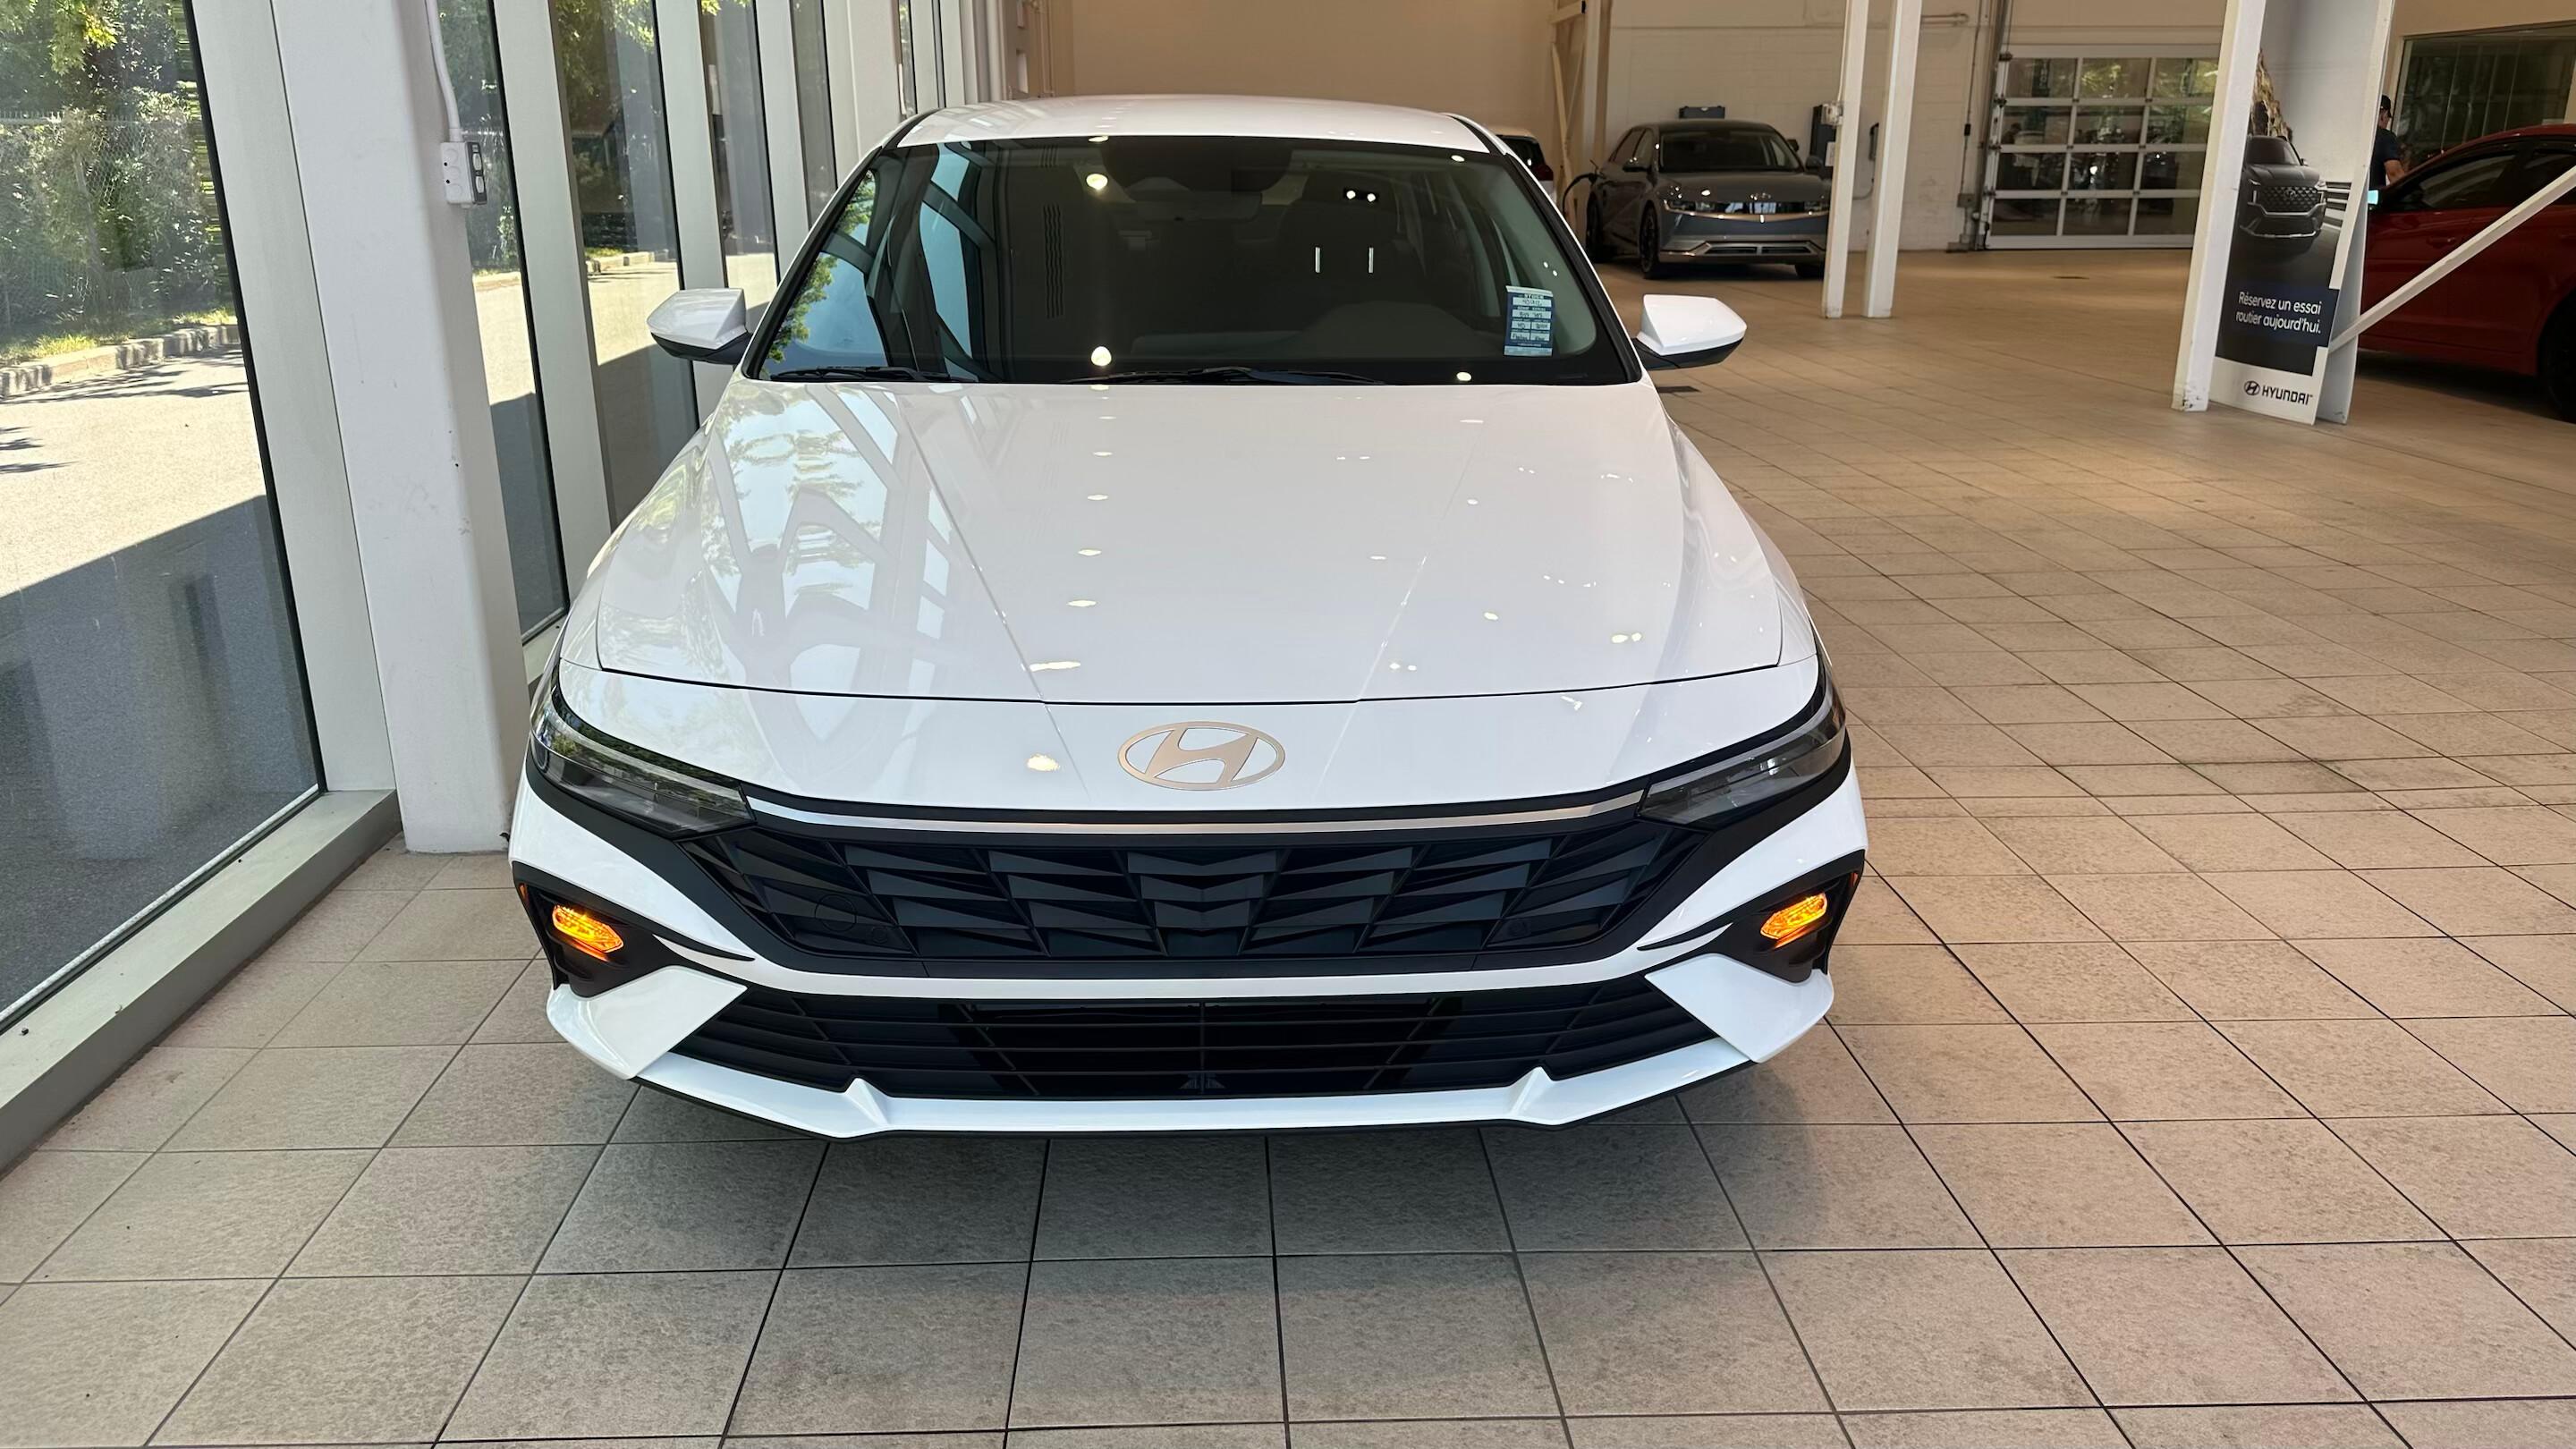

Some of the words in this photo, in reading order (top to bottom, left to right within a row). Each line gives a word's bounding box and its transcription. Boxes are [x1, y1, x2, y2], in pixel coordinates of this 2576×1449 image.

[2239, 292, 2276, 309] Réservez
[2278, 300, 2291, 311] un
[2293, 301, 2322, 315] essai
[2236, 310, 2262, 325] routier
[2263, 314, 2321, 334] aujourd'hui.
[2262, 385, 2309, 405] HYUNDAI
